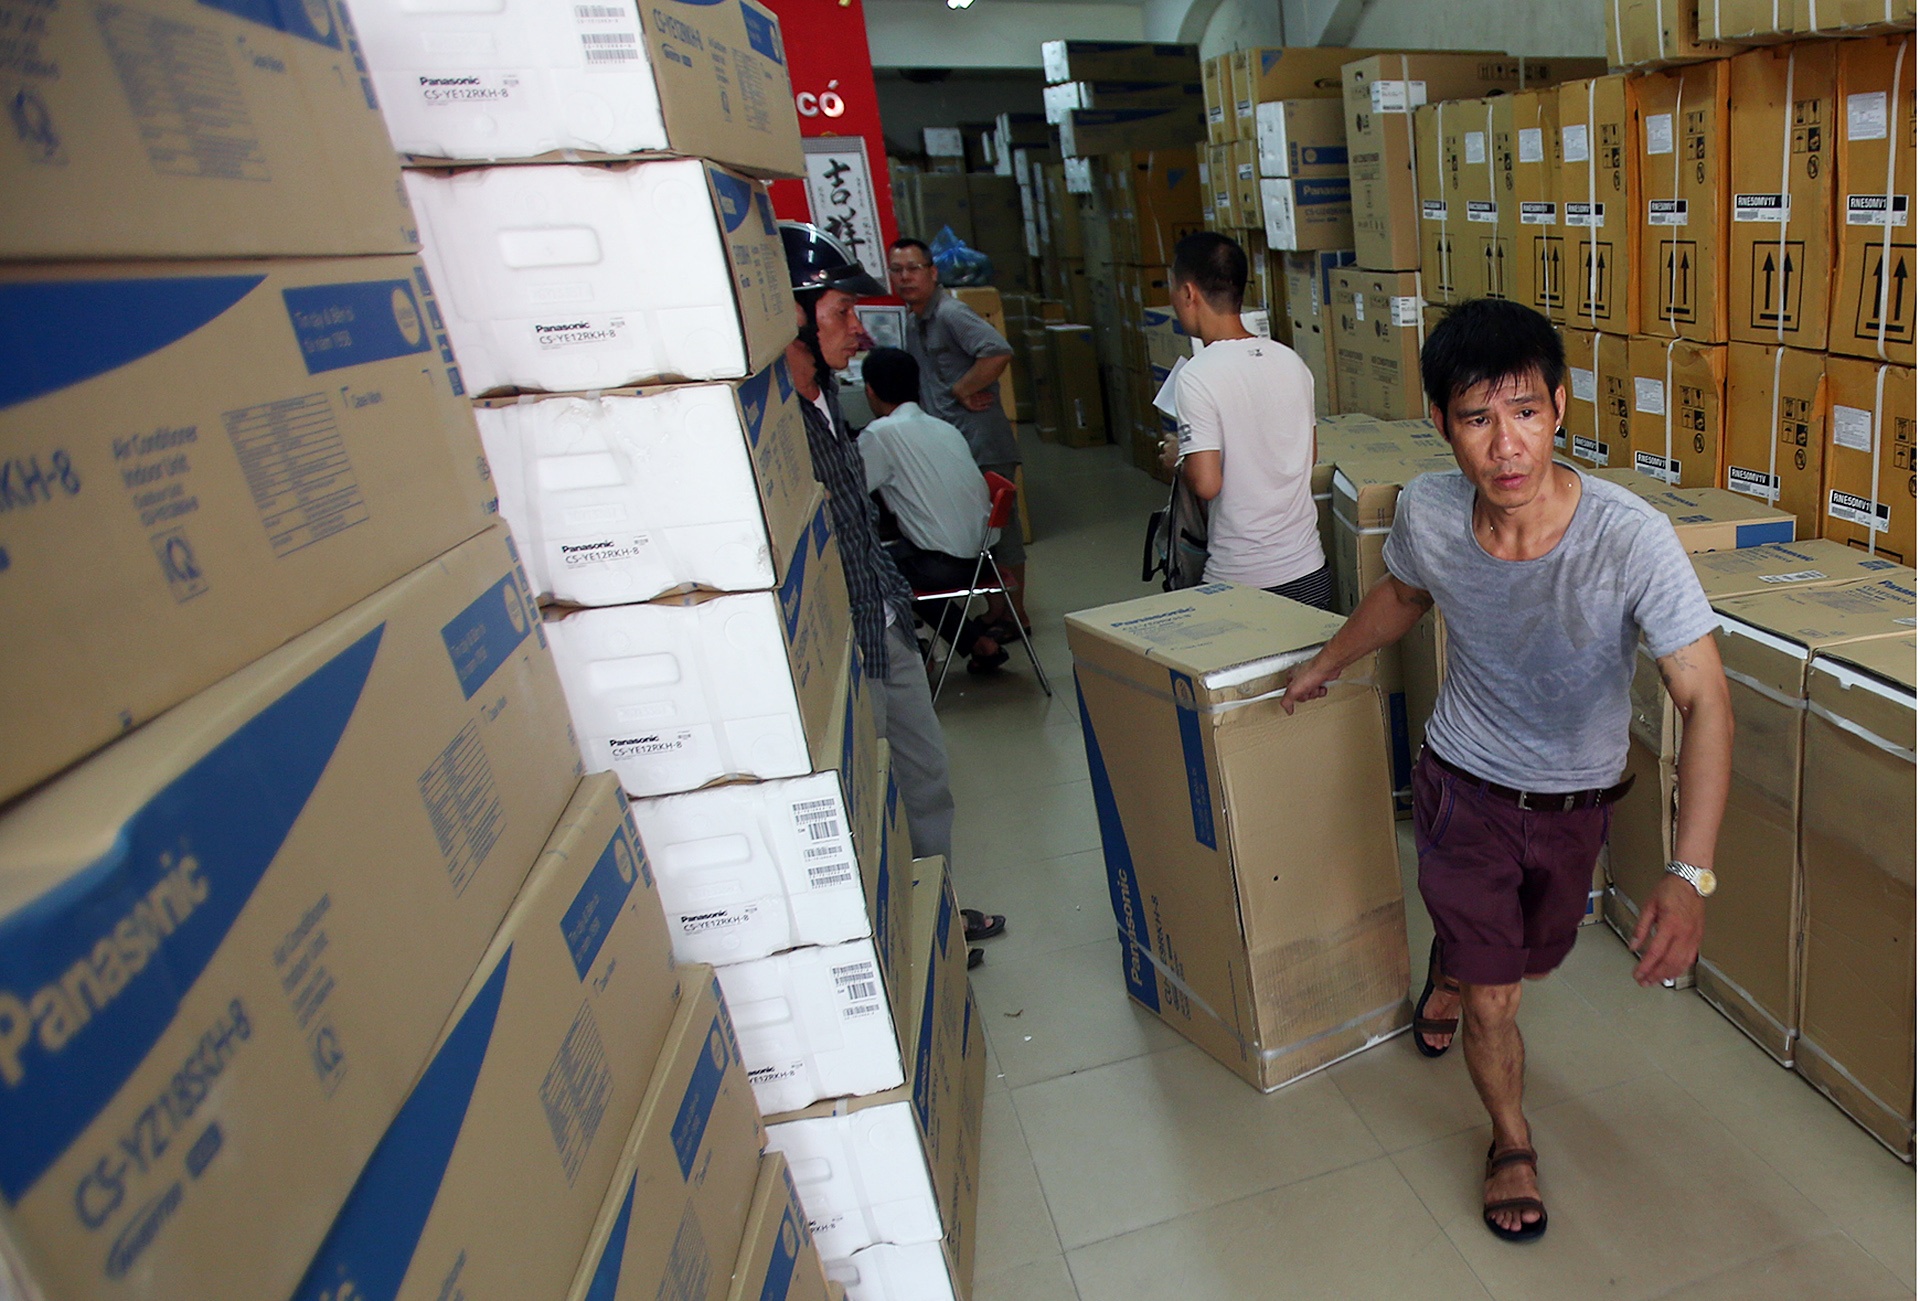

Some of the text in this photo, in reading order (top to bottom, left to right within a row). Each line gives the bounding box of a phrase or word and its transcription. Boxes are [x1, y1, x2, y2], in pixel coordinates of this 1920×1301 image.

[419, 76, 480, 86] Panasonic
[424, 88, 509, 100] CS-YE12RKH-8
[796, 80, 845, 118] có
[1737, 196, 1777, 207] RNE50MV1V
[1850, 197, 1887, 209] RNE50MV1
[535, 320, 590, 333] Panasonic
[539, 329, 617, 345] CS-YE12RKH-8
[1637, 453, 1666, 469] RNE50MV1
[1731, 468, 1767, 484] RNE50MV1V
[1832, 492, 1872, 511] RNE50MV1
[561, 540, 614, 553] Panasonic
[565, 547, 640, 564] CS-YE12RKH-8
[1110, 606, 1196, 628] Panasonic
[609, 734, 660, 747] Panasonic
[612, 741, 683, 757] CS-YE12RKH-8
[680, 909, 728, 923] Panasonic
[1118, 867, 1143, 987] Panasonic
